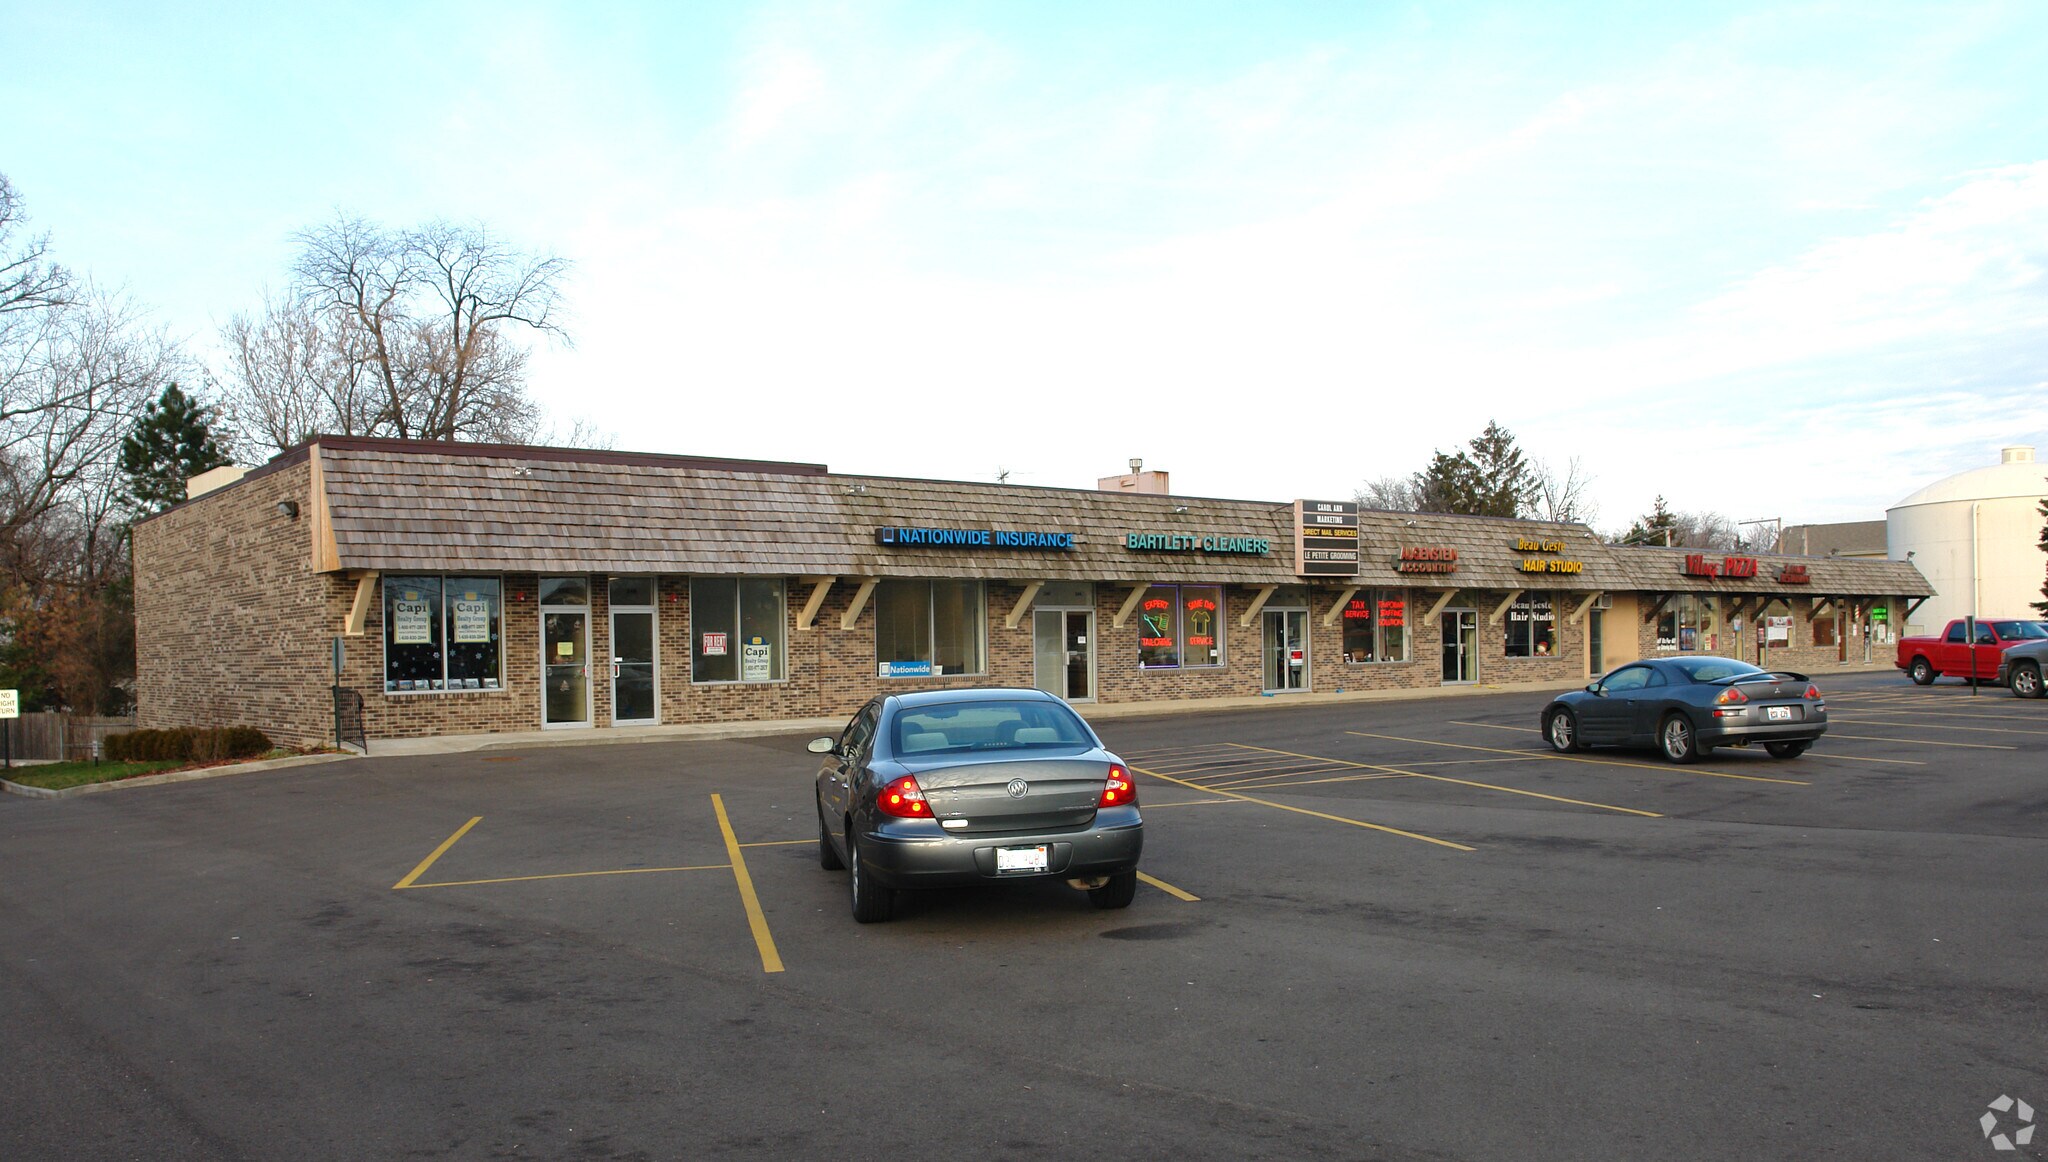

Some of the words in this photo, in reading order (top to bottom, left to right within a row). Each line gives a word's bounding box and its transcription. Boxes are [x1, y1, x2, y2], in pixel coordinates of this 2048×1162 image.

[1316, 515, 1343, 524] MARKETING
[899, 527, 991, 545] NATIONWIDE
[995, 531, 1074, 547] INSURANCE
[1126, 533, 1198, 551] BARTLETT
[1202, 536, 1270, 553] CLEANERS
[1518, 537, 1539, 551] Beau
[1542, 538, 1567, 552] Geste
[1305, 551, 1311, 559] LE
[1312, 551, 1329, 560] PETITE
[1330, 552, 1357, 560] GROOMING
[1400, 561, 1457, 572] ACCOUNTING
[1523, 559, 1546, 572] HAIR
[1549, 560, 1583, 573] STUDIO
[1723, 557, 1758, 577] PIZZA
[396, 602, 427, 614] Capi
[456, 602, 486, 614] Capi
[1144, 600, 1169, 610] EXPERT
[1350, 600, 1365, 609] TAX
[1511, 601, 1530, 609] Beau
[1345, 610, 1370, 619] SERVICE
[1510, 612, 1529, 621] Hair
[1532, 612, 1556, 621] Studio
[704, 635, 713, 647] FOR
[714, 635, 726, 647] RENT
[1189, 636, 1214, 646] SERVICE
[745, 647, 768, 658] Capi
[890, 665, 931, 674] Nationwide
[0, 699, 15, 707] IGHT
